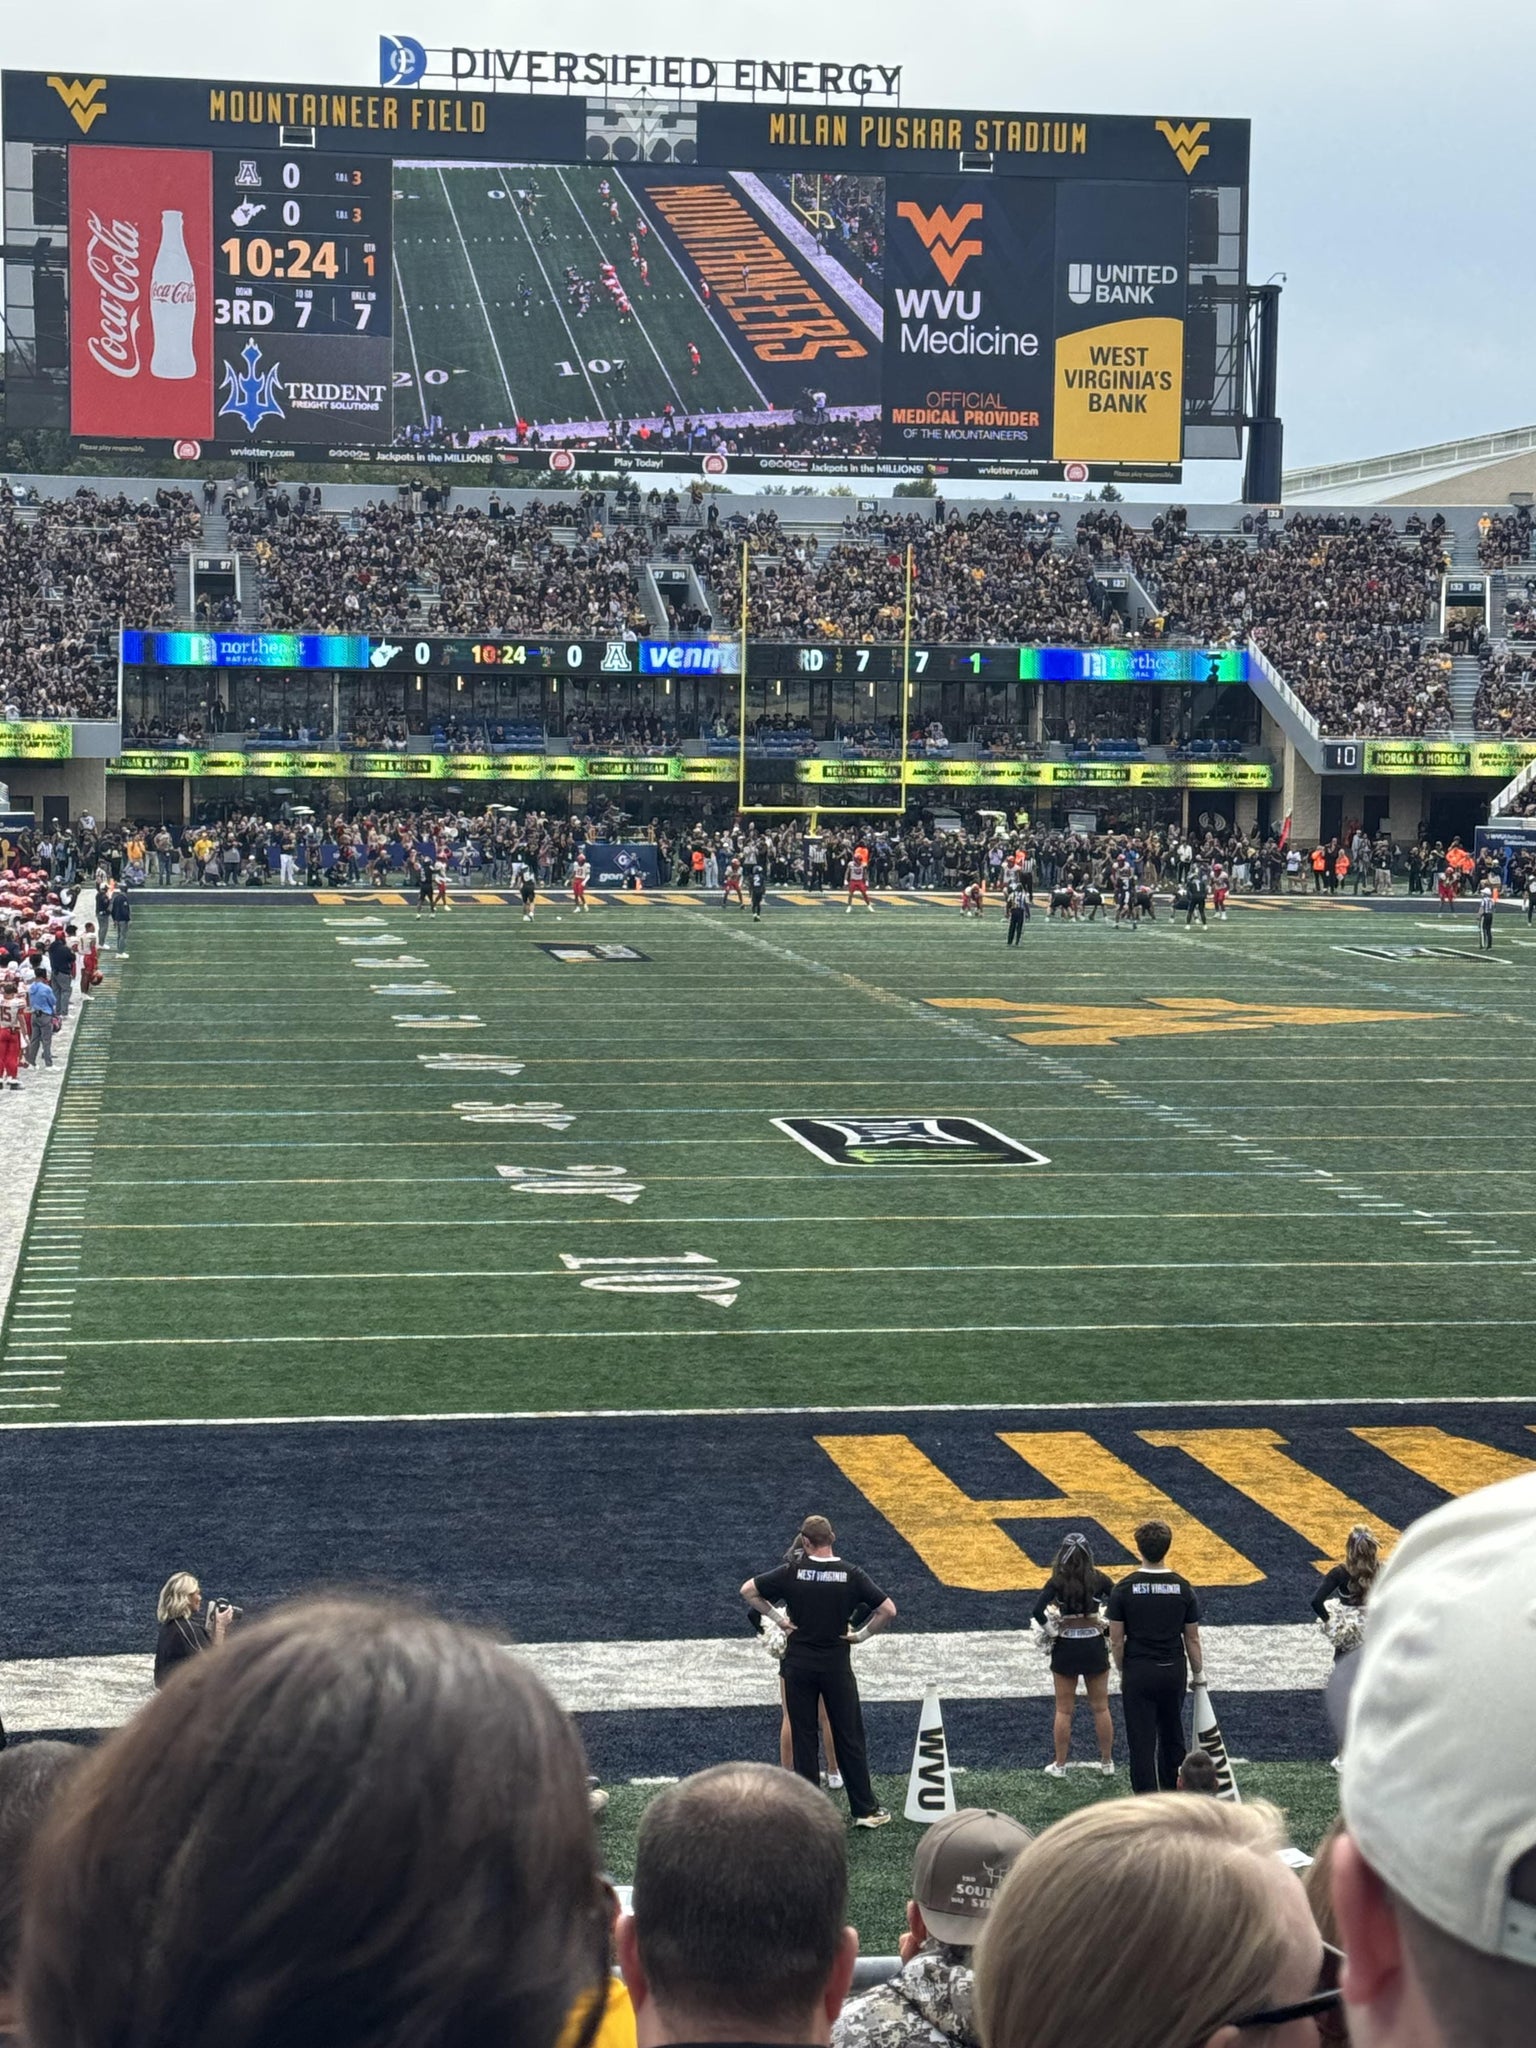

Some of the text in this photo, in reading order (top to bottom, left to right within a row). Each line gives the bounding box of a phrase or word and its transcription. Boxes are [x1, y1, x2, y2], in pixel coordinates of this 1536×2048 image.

[452, 47, 902, 96] DIVERSIFIED ENERGY
[210, 89, 486, 133] MOUNTAINEER FIELD
[769, 112, 1087, 154] MILAN PUSKAR STADIUM
[282, 162, 300, 189] 0
[352, 170, 362, 186] 3
[282, 200, 300, 226] 0
[352, 208, 362, 222] 3
[221, 238, 339, 279] 10:24
[363, 255, 375, 276] 1
[1096, 264, 1178, 285] UNITED
[86, 207, 141, 378] Coca-Cola
[1095, 285, 1155, 305] BANK
[214, 299, 274, 326] 3RD
[294, 301, 312, 328] 7
[895, 288, 981, 321] WVU
[354, 303, 372, 330] 7
[900, 324, 1039, 356] Medicine
[1089, 346, 1149, 368] WEST
[1064, 369, 1173, 391] VIRGINIA'S
[284, 382, 387, 402] TRIDENT
[926, 391, 1007, 409] OFFICIAL
[291, 400, 380, 411] FREIGHT SOLUTIONS
[1088, 393, 1148, 414] BANK
[892, 408, 1039, 427] MEDICAL PROVIDER
[903, 427, 1028, 441] OF THE MOUNTAINEERS
[230, 447, 295, 459] wvlottery.com
[375, 452, 415, 463] Jackpots
[417, 453, 426, 462] in
[428, 453, 443, 462] the
[444, 454, 493, 464] MILLIONS!
[614, 457, 663, 470] Play Today!
[811, 463, 848, 474] Jackpots
[850, 463, 859, 473] in
[860, 464, 875, 473] the
[876, 464, 924, 474] MILLIONS!
[977, 466, 1039, 477] wvlottery.com
[220, 637, 306, 655] northet
[414, 642, 430, 665] 0
[472, 644, 526, 665] 10:24
[567, 645, 583, 668] 0
[650, 645, 739, 669] venm
[797, 649, 824, 671] RD
[856, 650, 870, 672] 7
[915, 651, 929, 673] 7
[969, 652, 981, 673] 1
[1337, 746, 1355, 766] 10
[1376, 752, 1414, 765] MORGAN
[1426, 752, 1467, 766] MORGAN
[558, 1251, 741, 1293] 10
[796, 1568, 815, 1582] WEST
[1132, 1582, 1149, 1594] WEST
[917, 1726, 945, 1811] WVU
